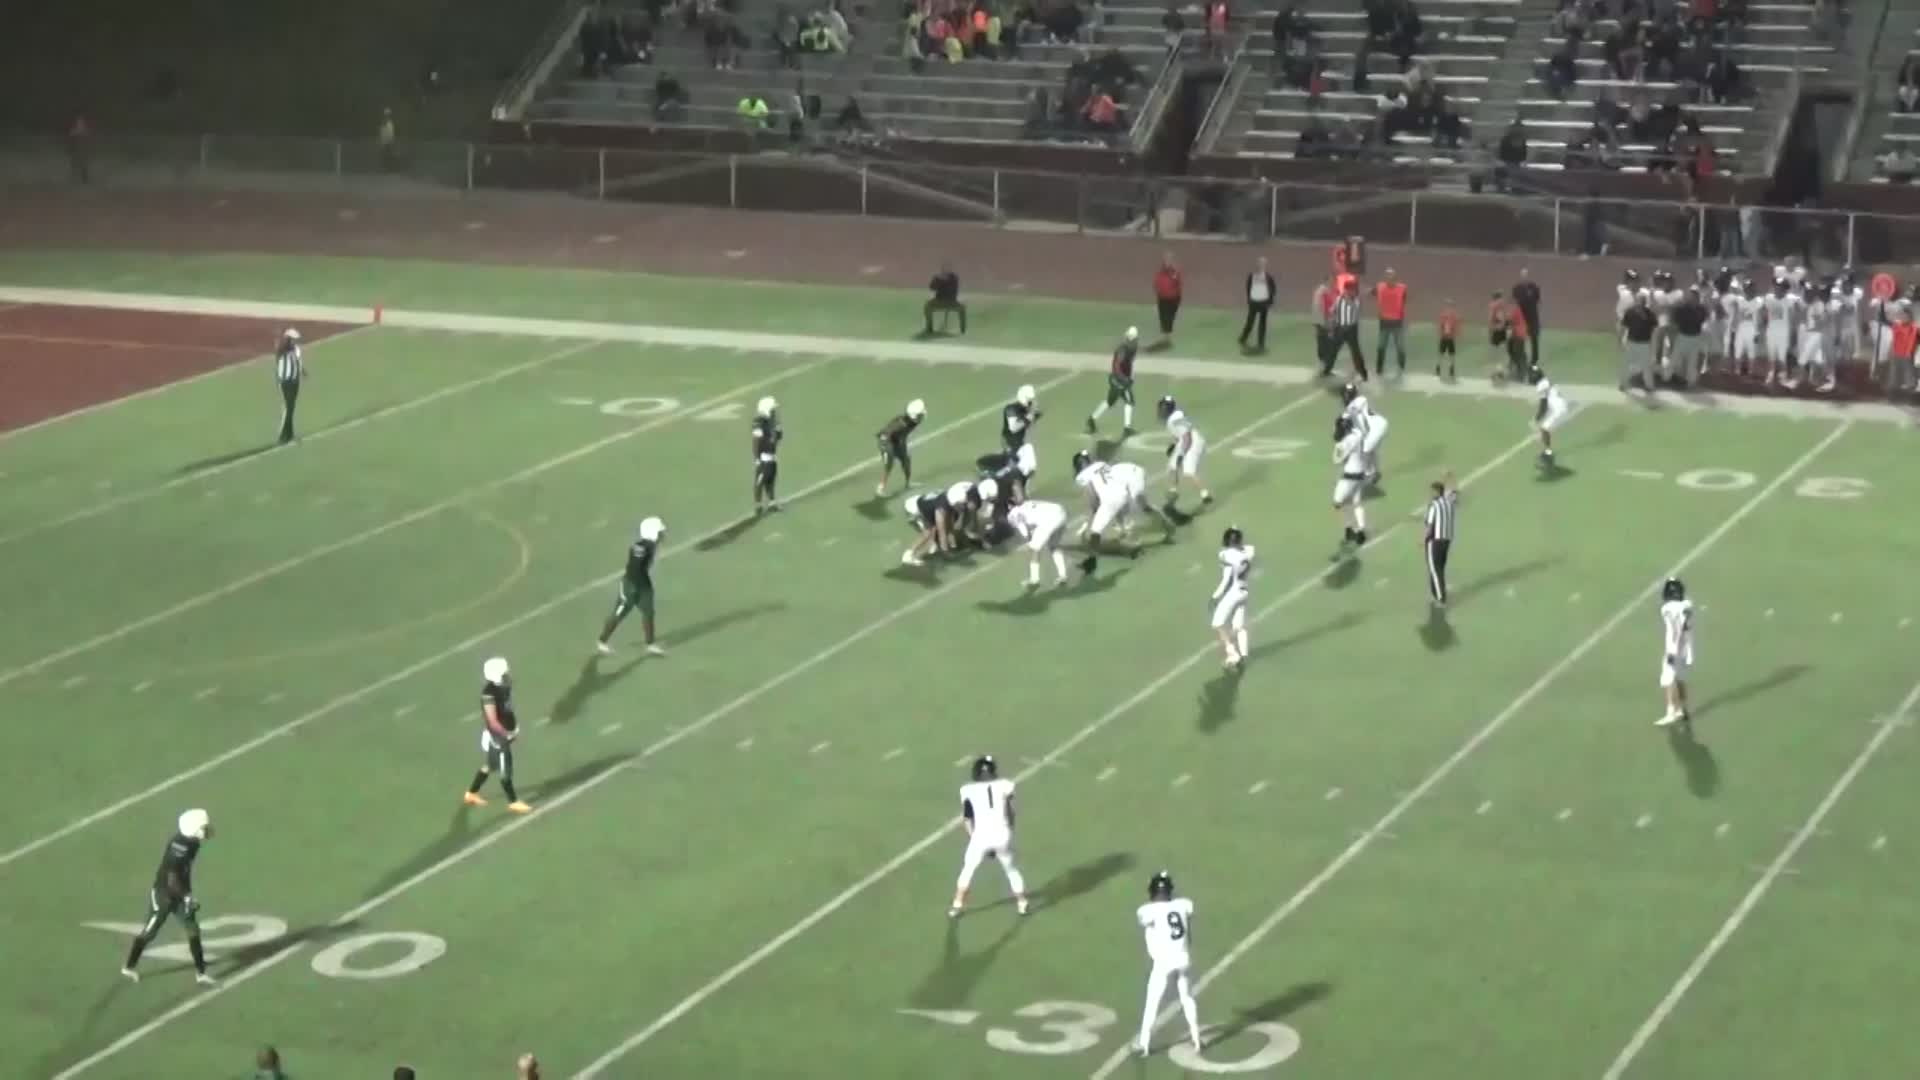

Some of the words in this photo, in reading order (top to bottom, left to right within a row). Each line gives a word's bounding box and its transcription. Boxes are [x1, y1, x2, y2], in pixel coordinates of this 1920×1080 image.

[1675, 468, 1874, 499] 30
[987, 784, 994, 808] 1
[1167, 911, 1184, 941] 9
[140, 915, 447, 979] 20
[985, 1001, 1301, 1073] 30
